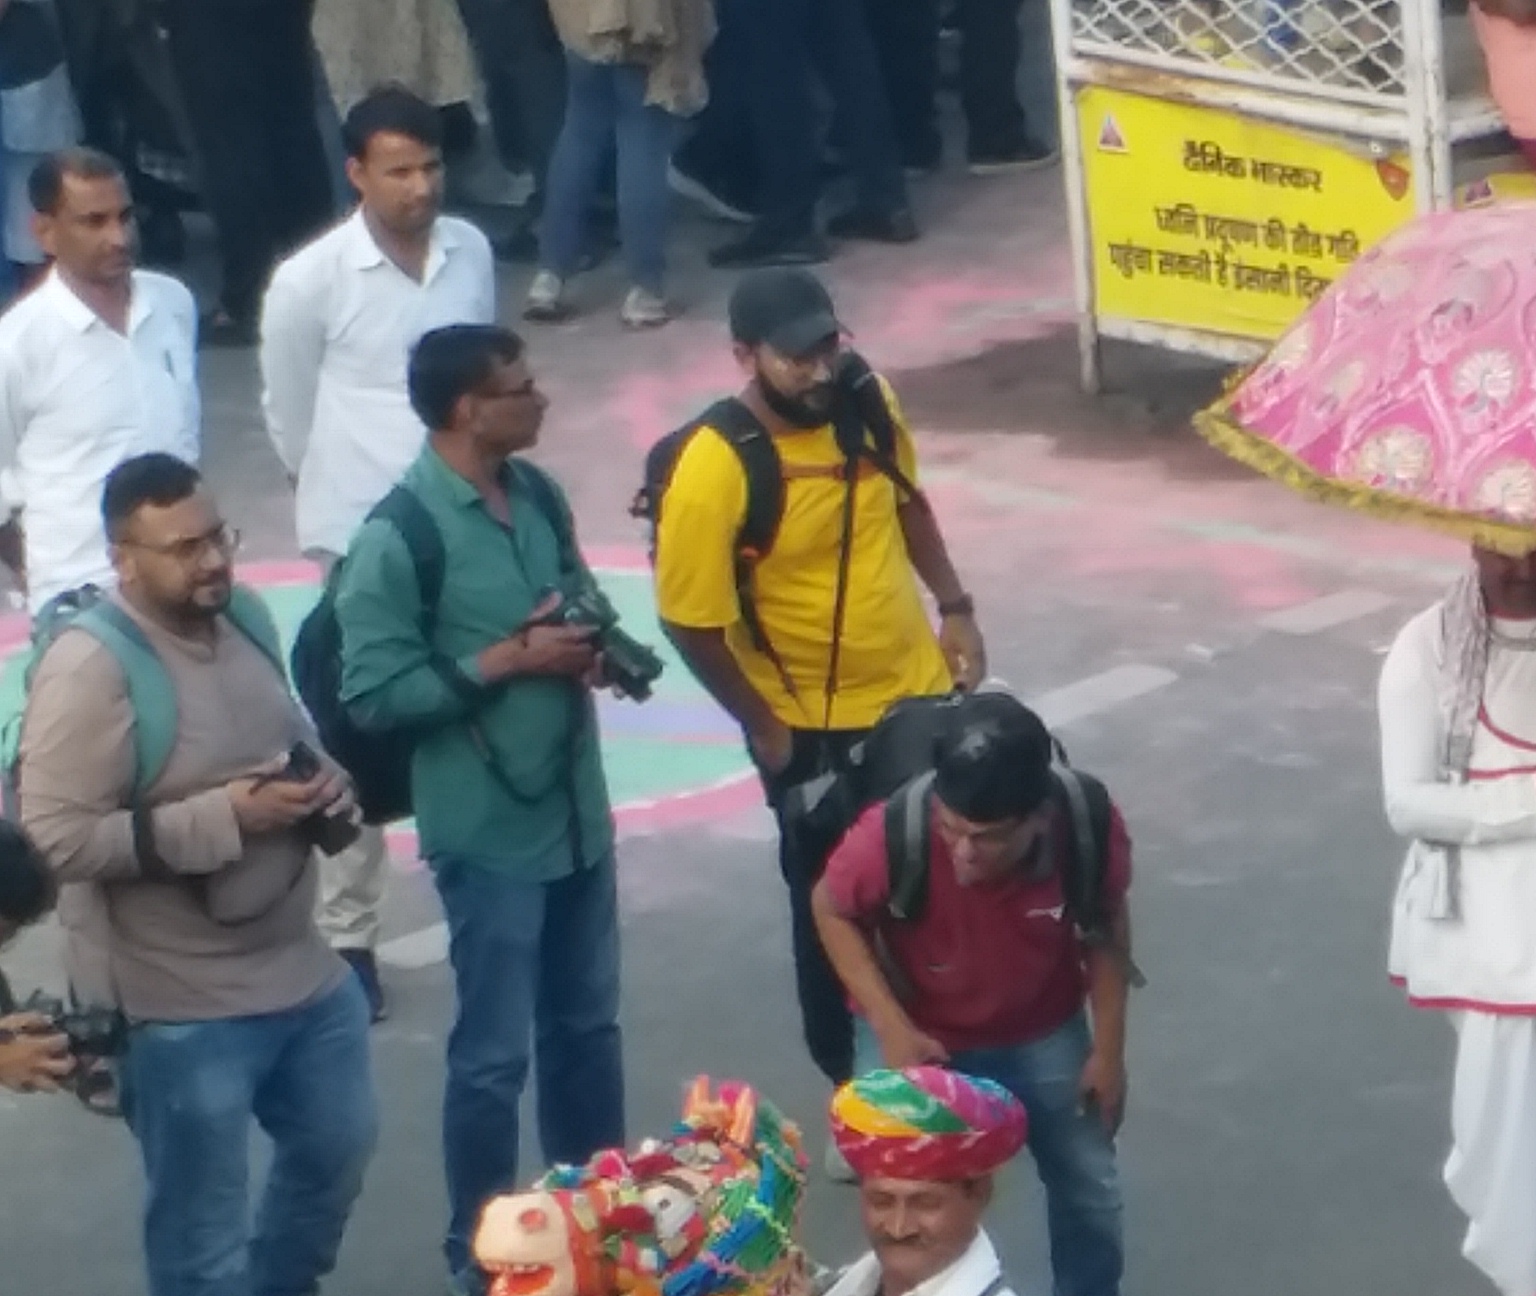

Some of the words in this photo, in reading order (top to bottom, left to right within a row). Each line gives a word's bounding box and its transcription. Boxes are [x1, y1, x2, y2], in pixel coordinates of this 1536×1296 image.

[1183, 140, 1247, 178] दैनिक
[1251, 158, 1323, 193] भास्कर
[1260, 218, 1287, 252] की
[1212, 248, 1228, 287] है
